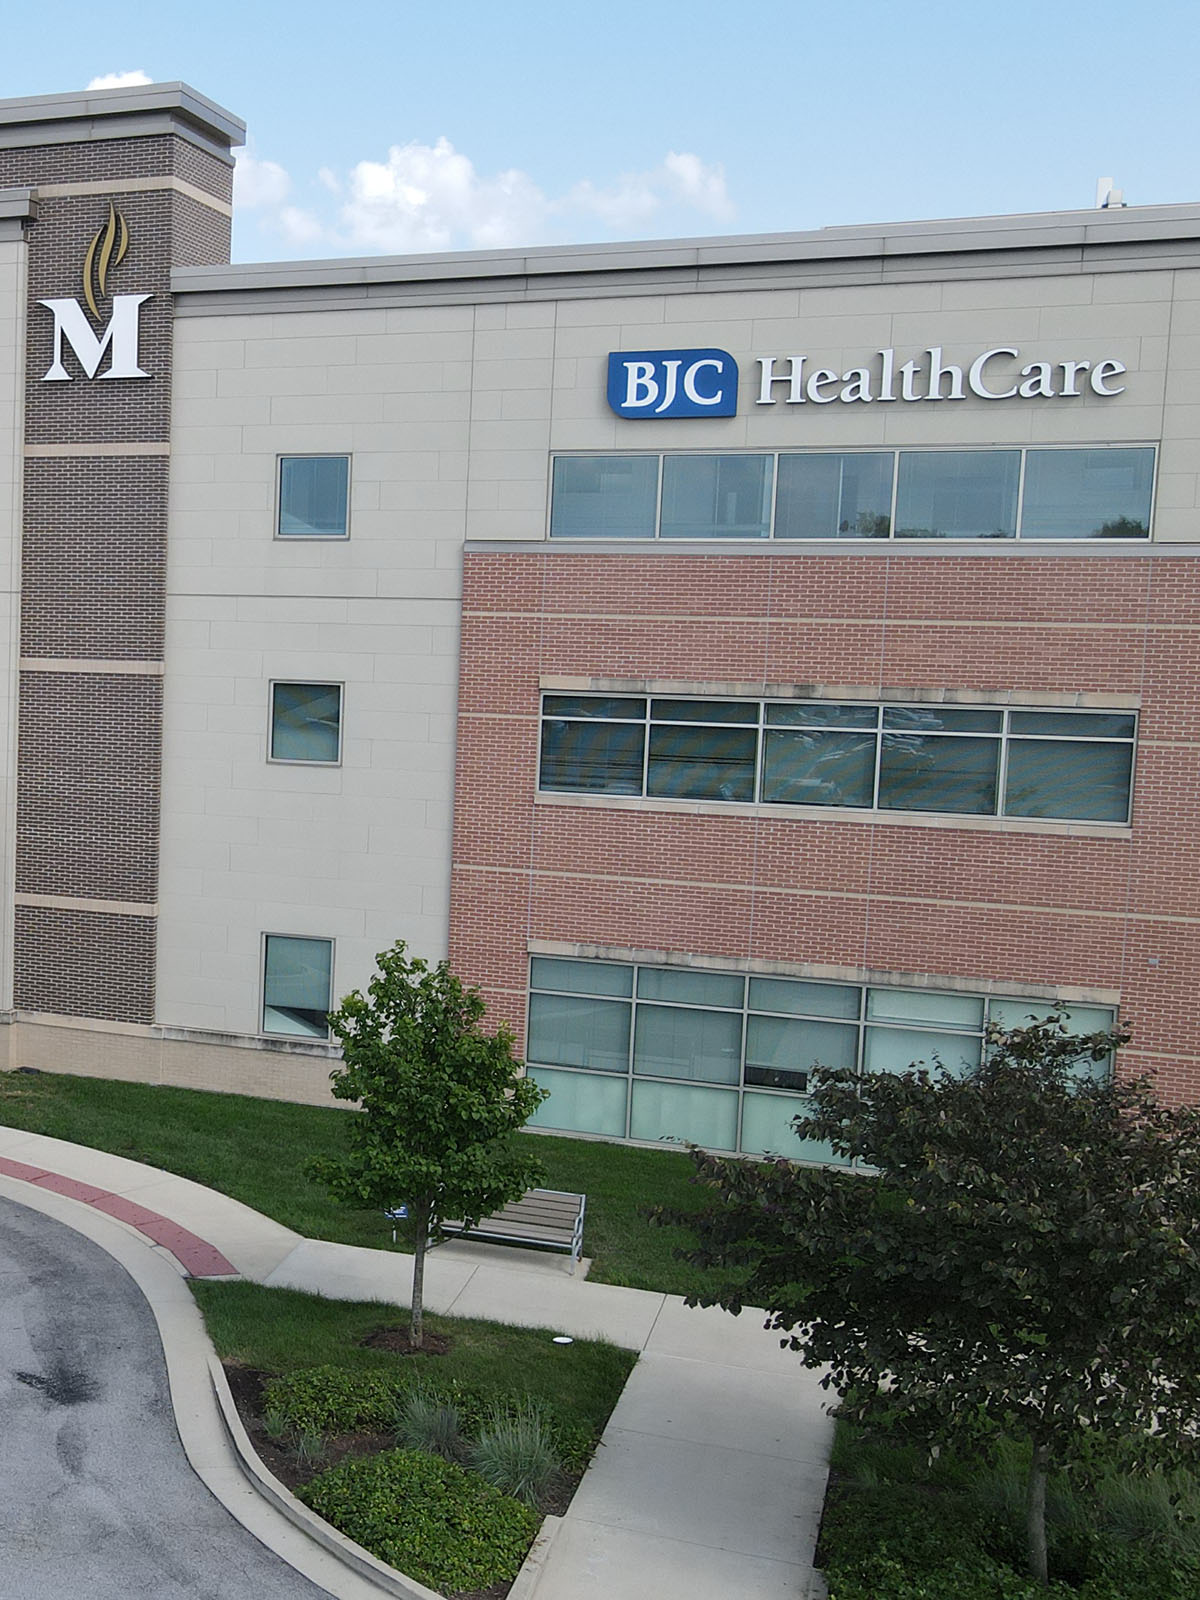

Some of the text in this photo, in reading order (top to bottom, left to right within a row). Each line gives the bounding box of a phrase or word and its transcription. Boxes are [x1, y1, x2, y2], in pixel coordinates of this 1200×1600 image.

[37, 293, 154, 381] M
[620, 346, 1127, 414] BJC HealthCare
